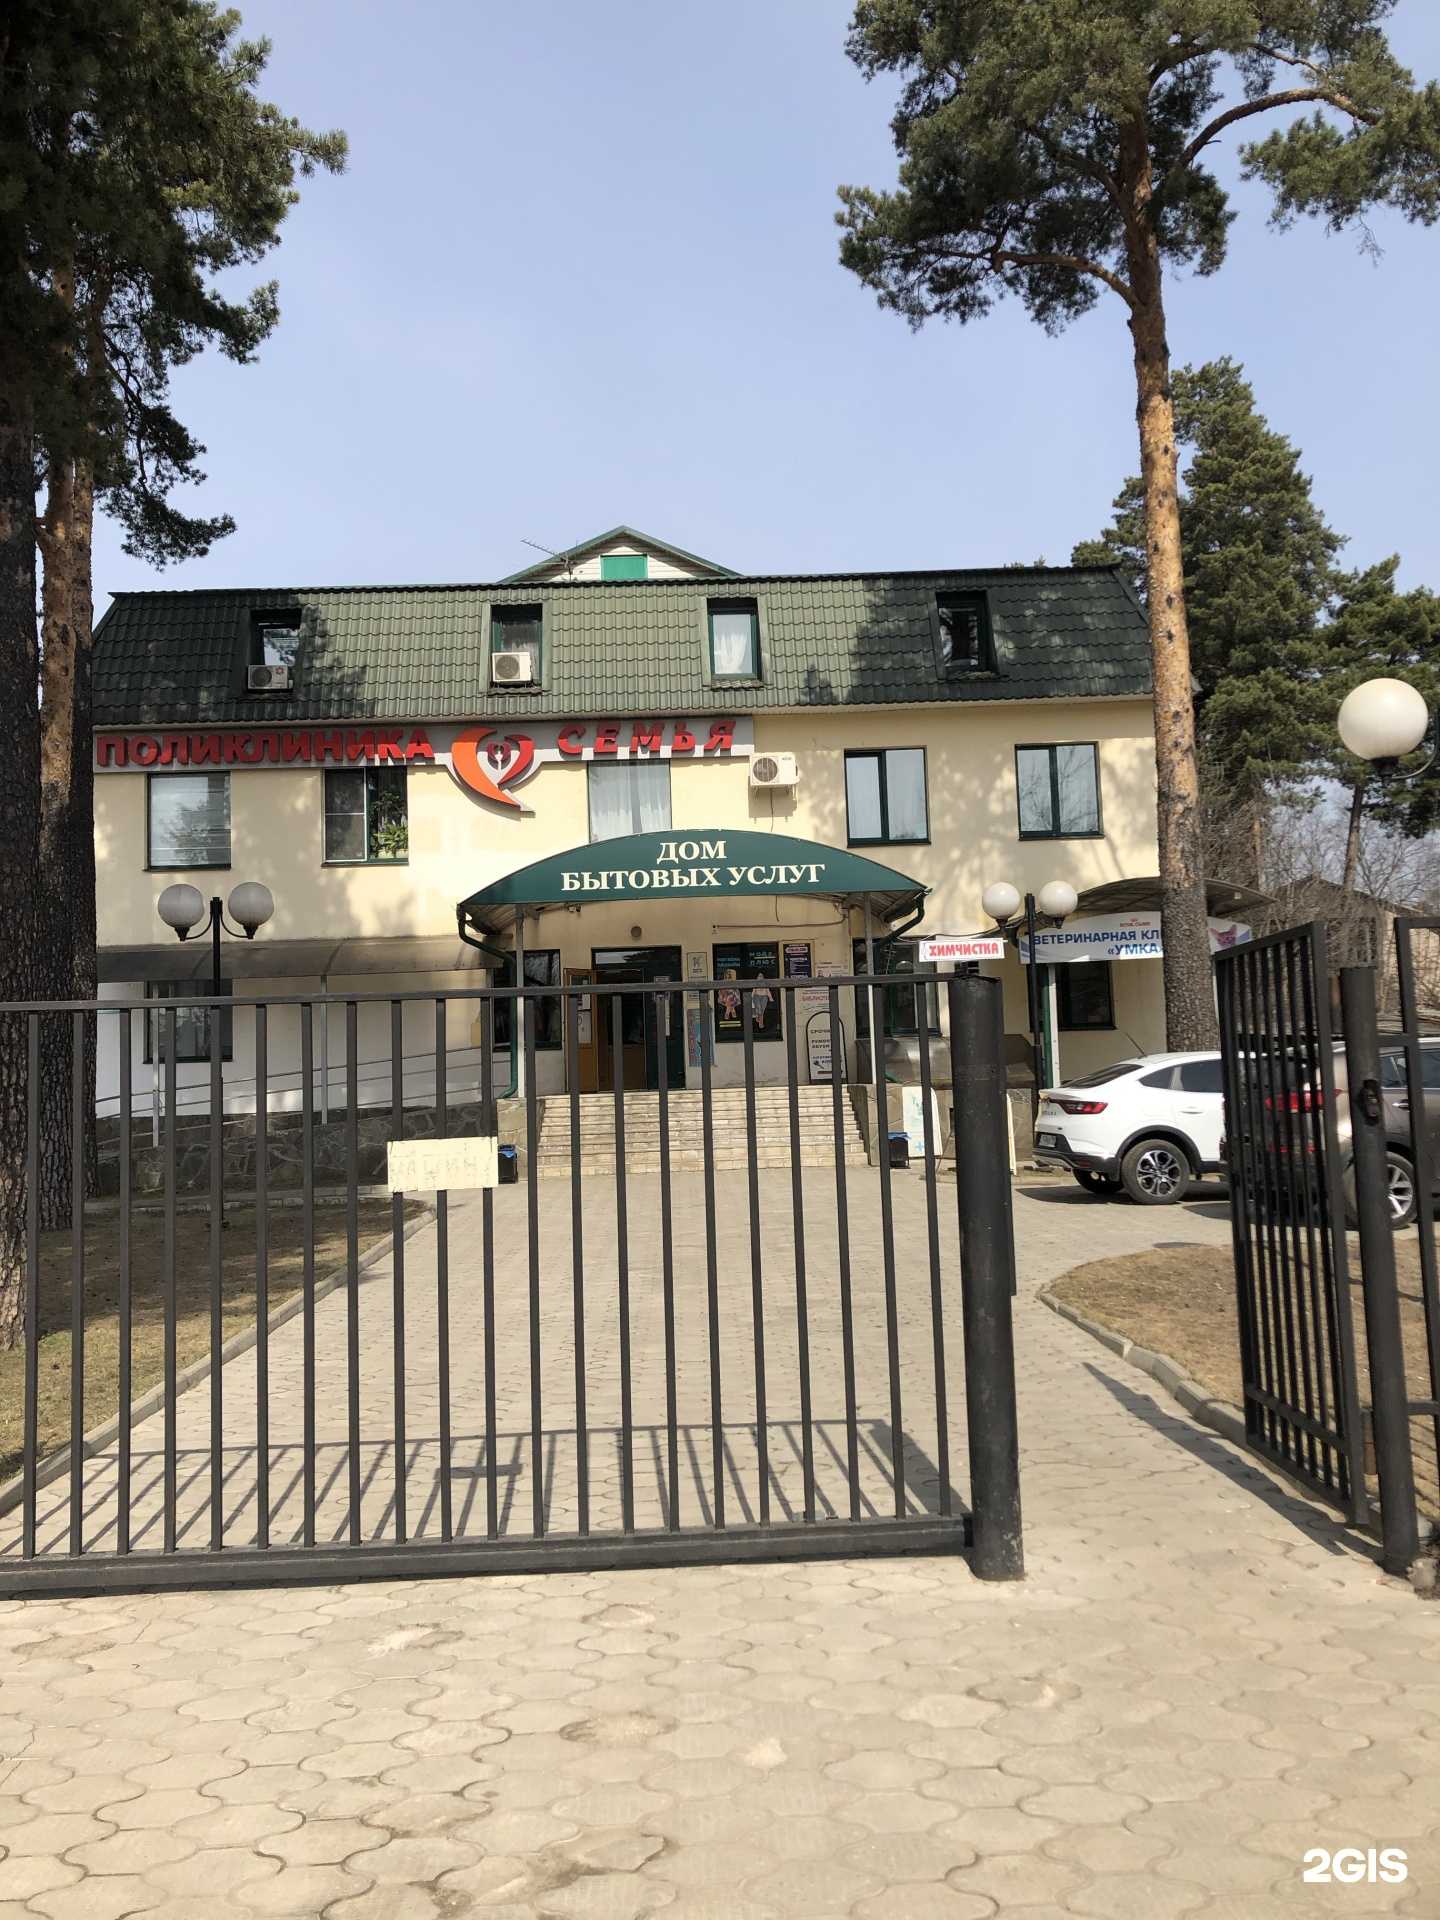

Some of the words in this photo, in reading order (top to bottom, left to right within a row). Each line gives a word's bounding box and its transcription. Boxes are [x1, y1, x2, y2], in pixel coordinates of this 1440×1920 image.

[96, 728, 436, 767] ПОЛИКЛИНИКА
[557, 719, 737, 755] СЕМЬЯ
[656, 840, 728, 864] ДОМ
[561, 867, 723, 891] БЫТОВЫХ
[727, 863, 826, 886] УСЛУГ
[1033, 930, 1137, 945] ВЕТЕРИНАРНАЯ
[1141, 929, 1160, 940] КЛ
[929, 943, 999, 956] ХИМЧИСТКА
